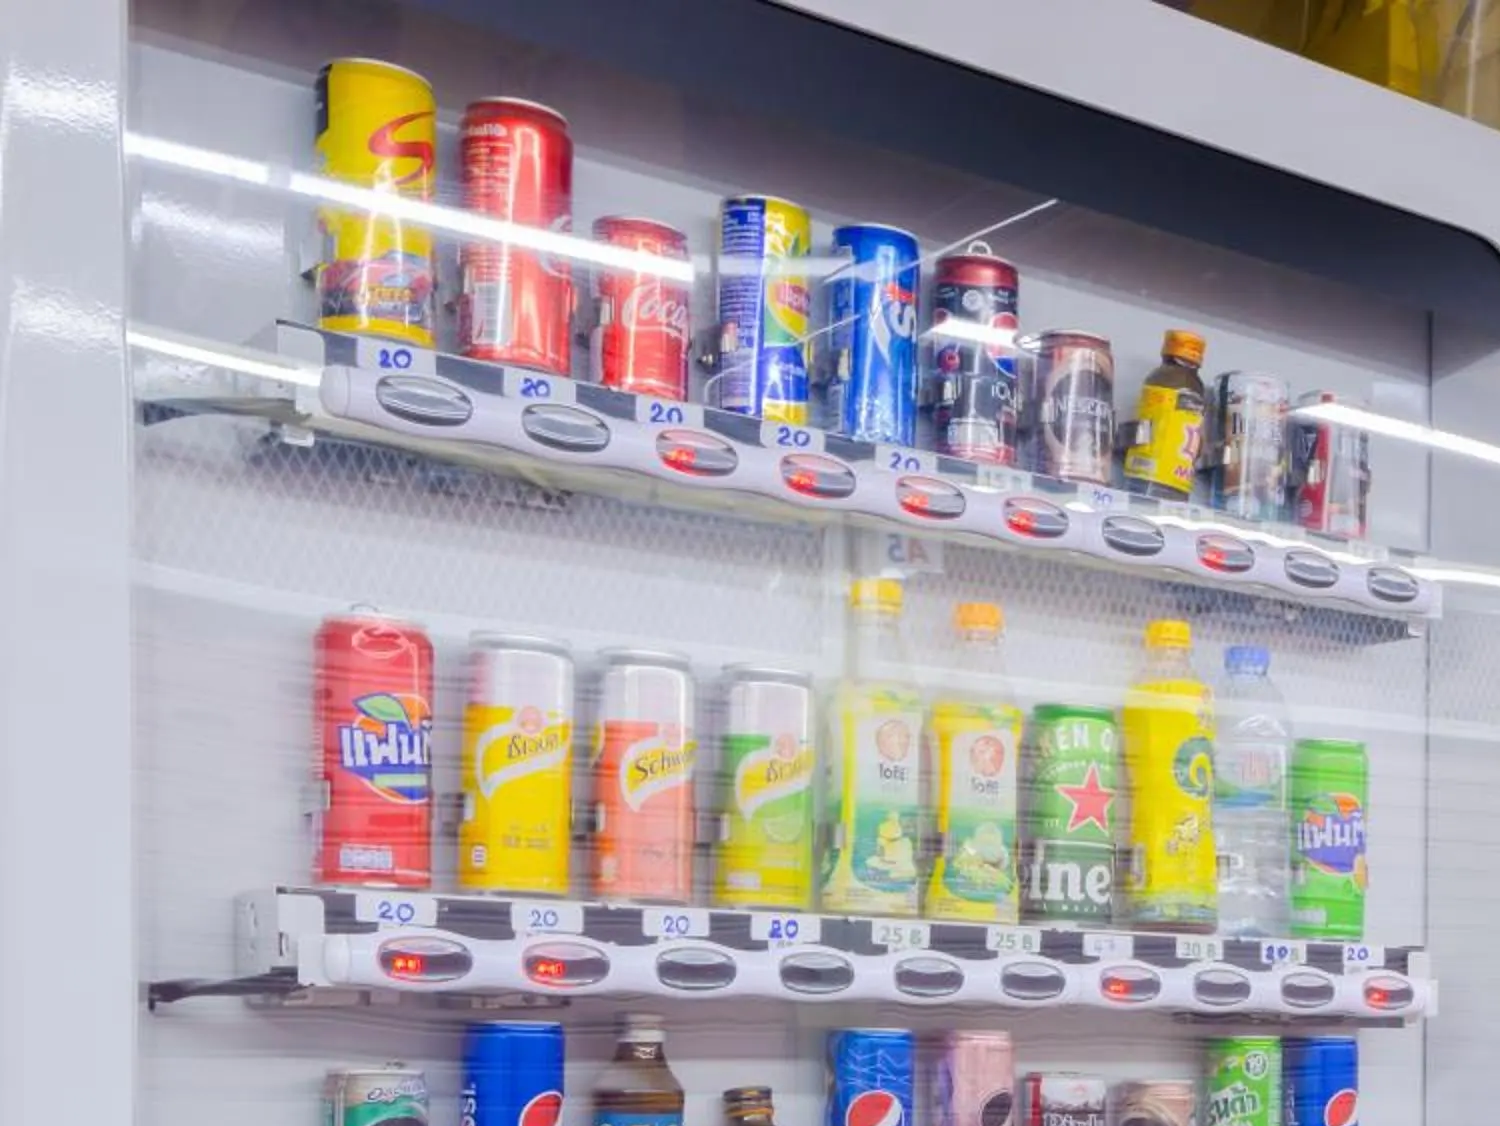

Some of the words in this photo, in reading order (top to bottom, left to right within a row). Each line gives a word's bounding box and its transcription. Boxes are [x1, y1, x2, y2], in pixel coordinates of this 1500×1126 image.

[377, 348, 413, 369] 20
[518, 377, 553, 399] 20
[650, 402, 685, 424] 20
[778, 427, 810, 448] 20
[890, 451, 921, 471] 20
[378, 902, 414, 923] 20
[530, 909, 559, 928] 20
[663, 915, 690, 934] 20
[768, 919, 800, 939] 20
[881, 927, 903, 944] 25
[995, 931, 1016, 948] 25
[1347, 947, 1369, 961] 20
